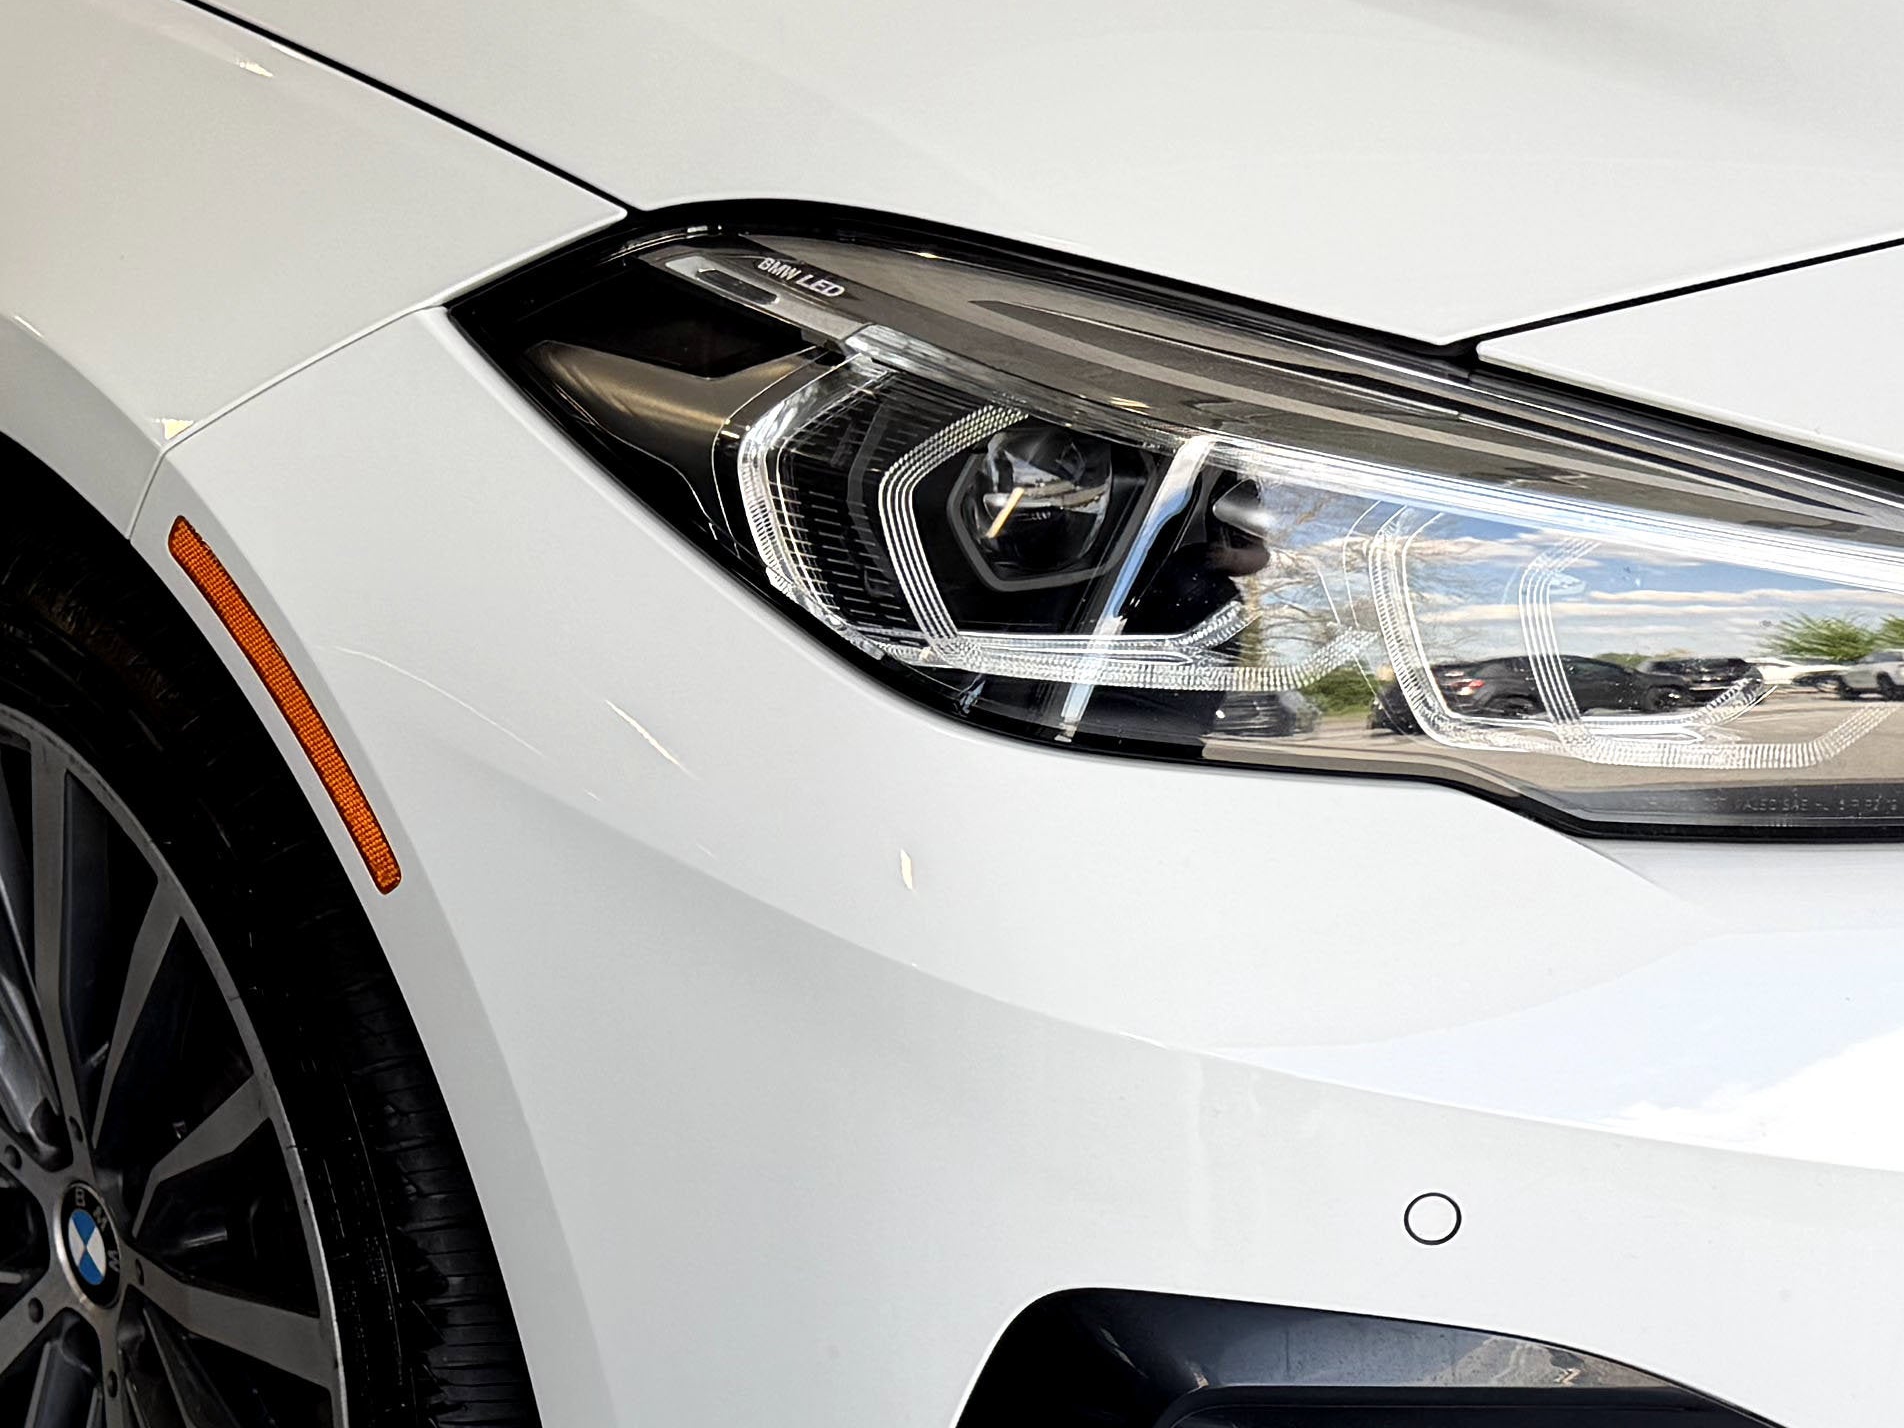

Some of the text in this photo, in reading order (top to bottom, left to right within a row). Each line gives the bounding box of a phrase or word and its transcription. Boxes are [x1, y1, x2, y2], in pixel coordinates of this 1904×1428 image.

[757, 257, 846, 297] BMW LED
[74, 1186, 121, 1272] BMW
